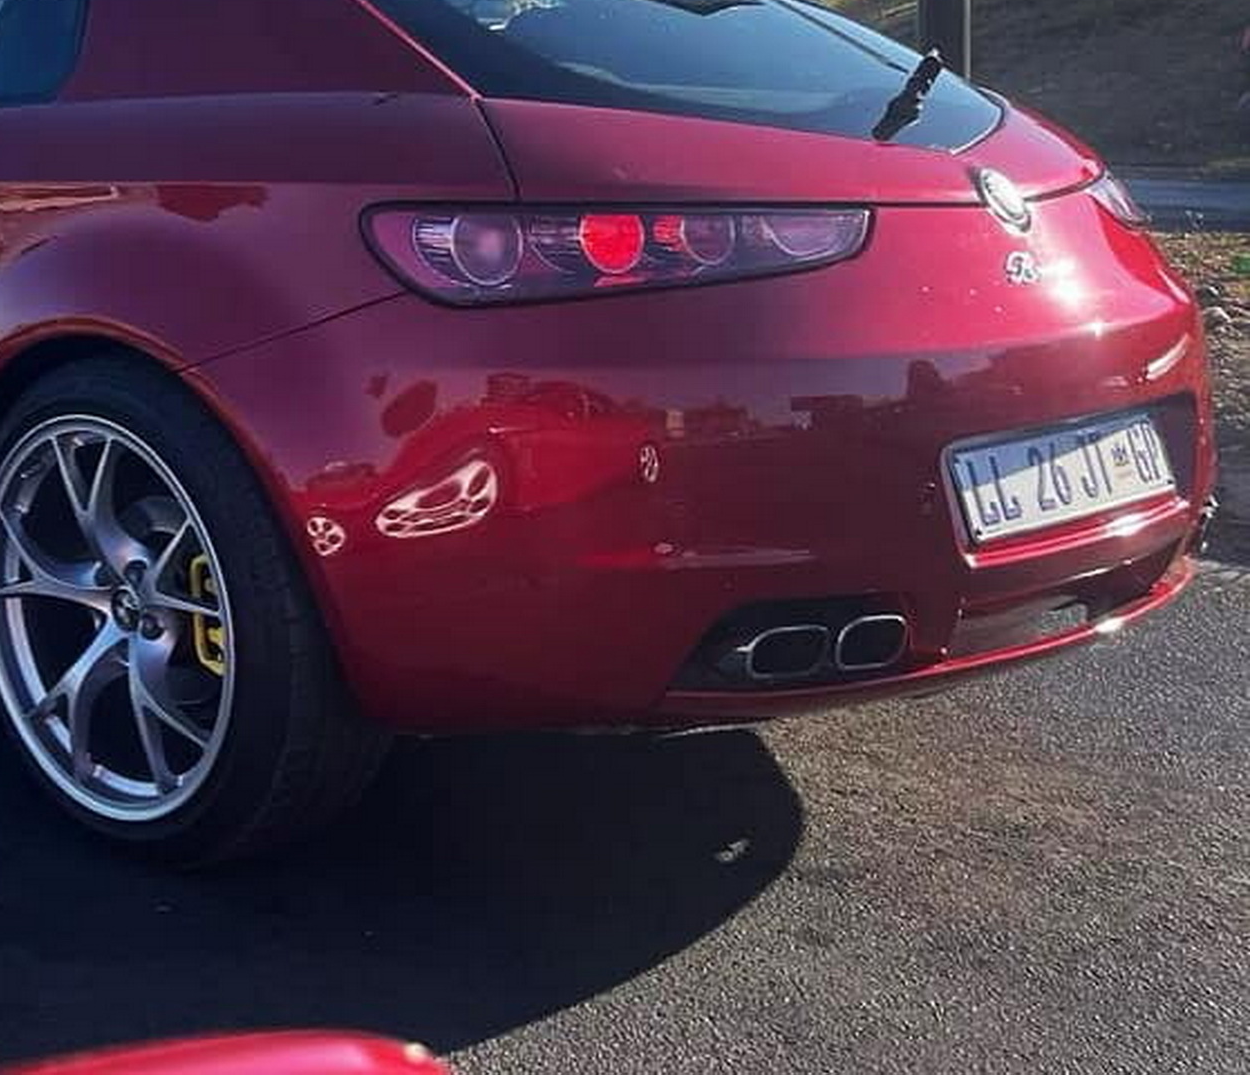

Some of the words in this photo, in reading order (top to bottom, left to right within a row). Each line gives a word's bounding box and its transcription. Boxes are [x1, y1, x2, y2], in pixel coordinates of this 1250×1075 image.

[967, 455, 1021, 526] LL
[1027, 443, 1071, 512] 26
[1126, 423, 1162, 483] GP
